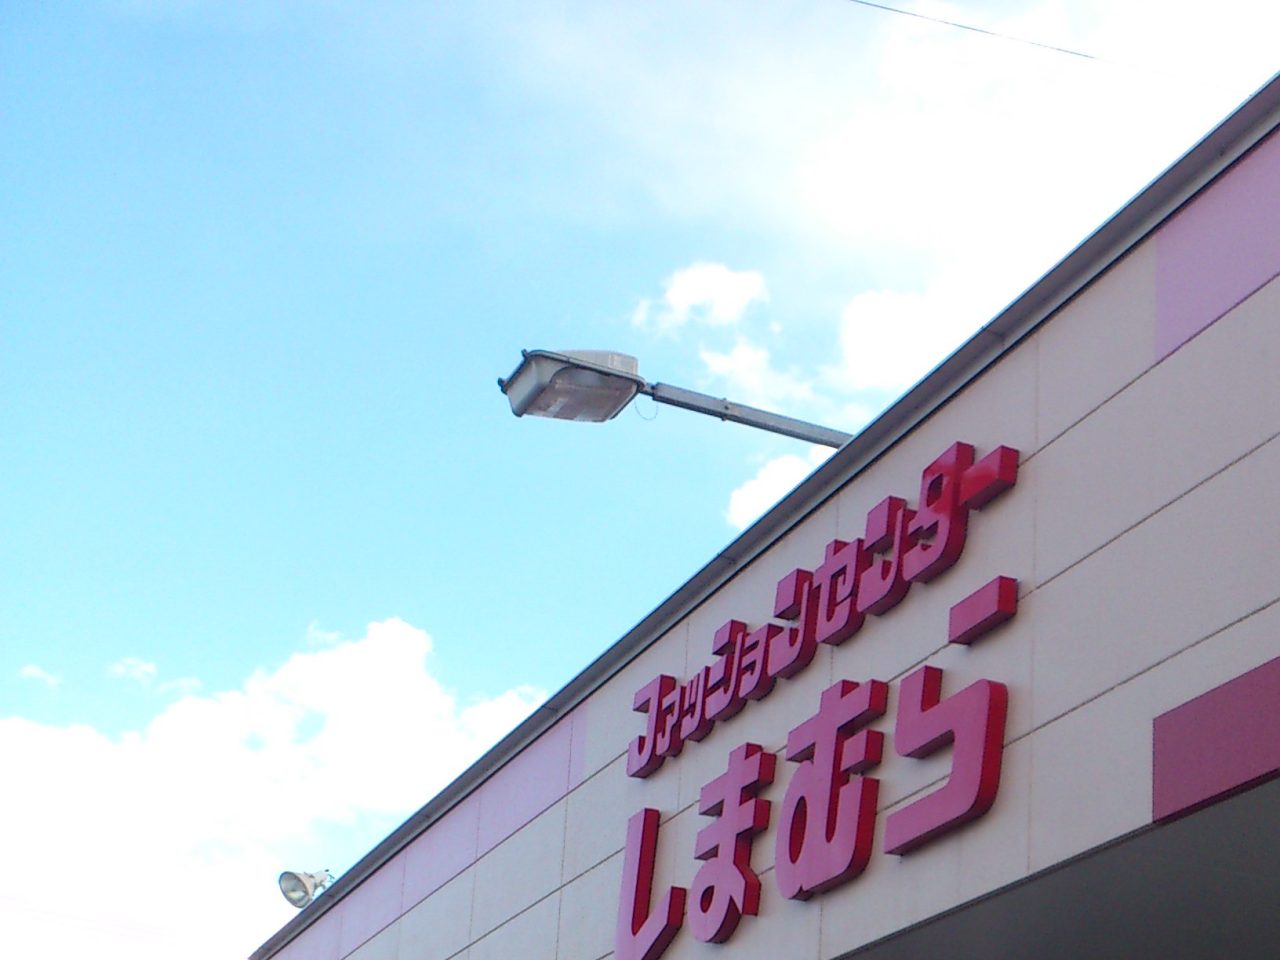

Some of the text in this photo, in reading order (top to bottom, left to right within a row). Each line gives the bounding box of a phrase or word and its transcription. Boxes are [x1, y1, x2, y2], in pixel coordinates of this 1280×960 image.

[627, 441, 1020, 778] ファッションセンター
